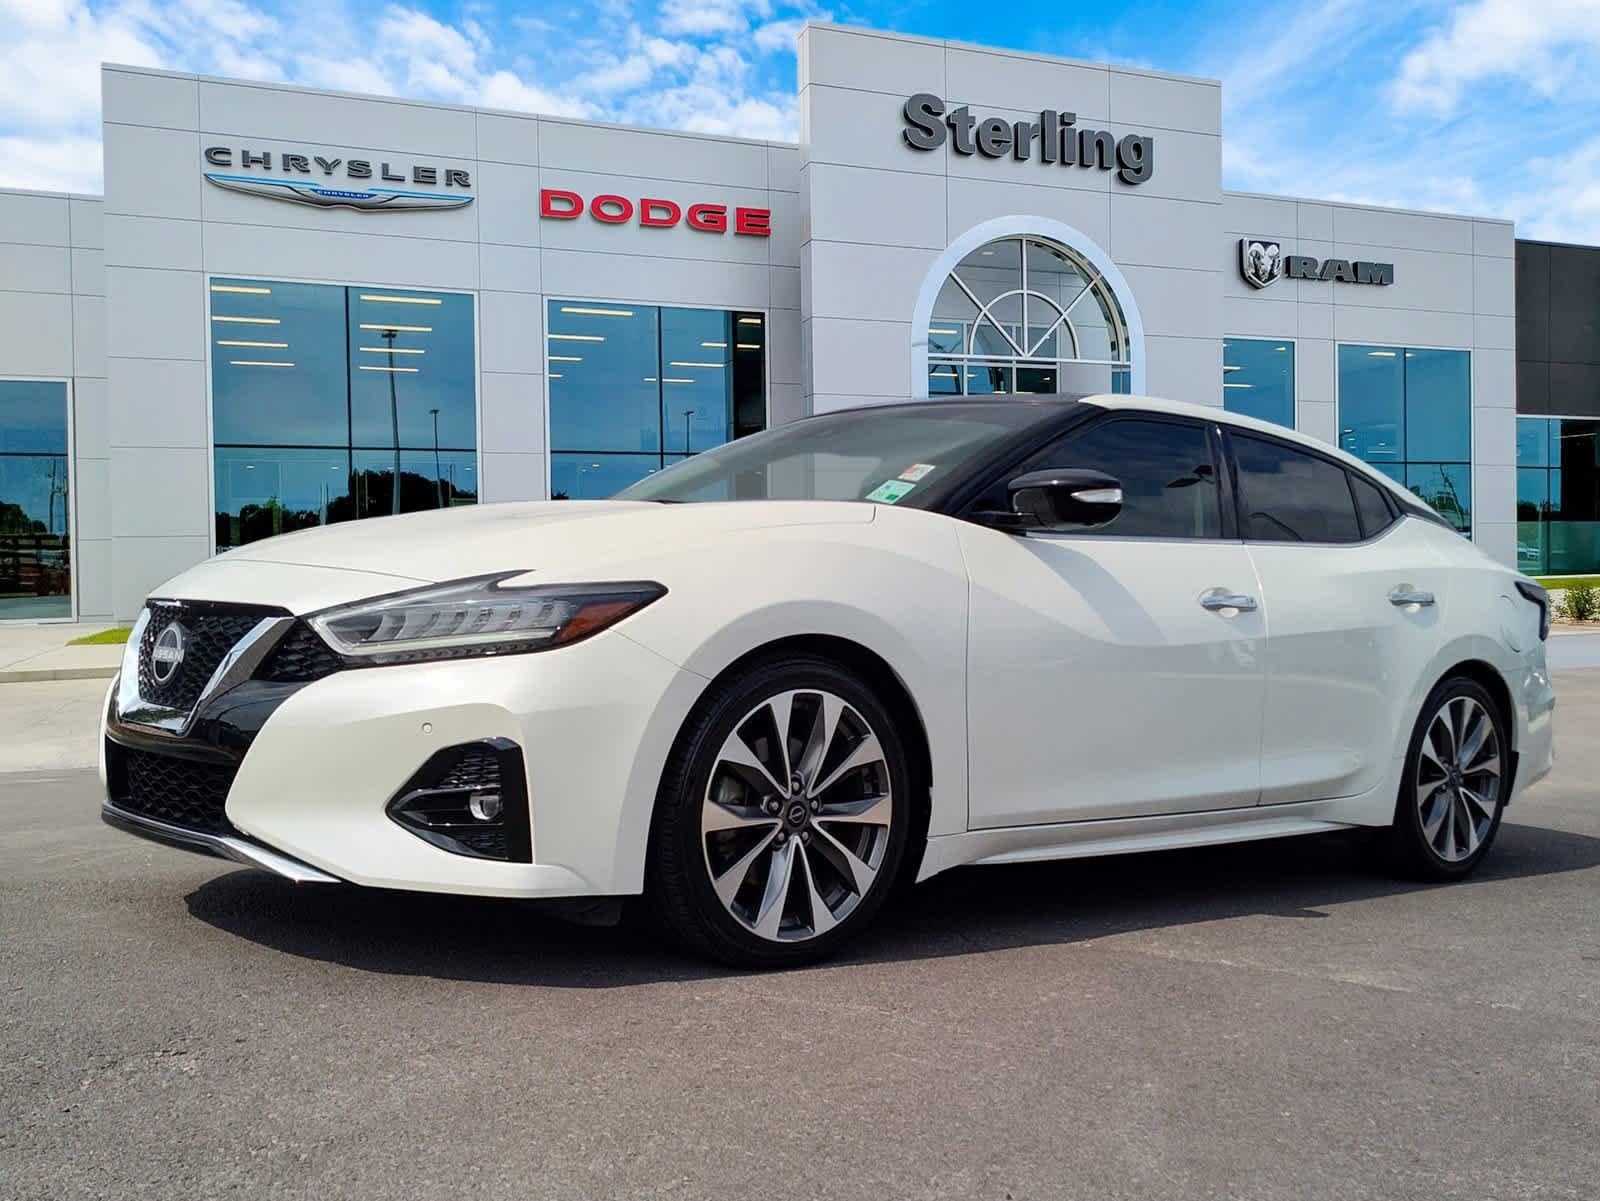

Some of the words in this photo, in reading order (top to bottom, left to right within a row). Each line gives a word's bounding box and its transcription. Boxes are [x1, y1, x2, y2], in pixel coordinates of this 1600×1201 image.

[903, 93, 1153, 184] Sterling
[204, 147, 471, 187] CHRYSLER
[540, 188, 771, 236] DODGE
[1285, 255, 1394, 285] RAM
